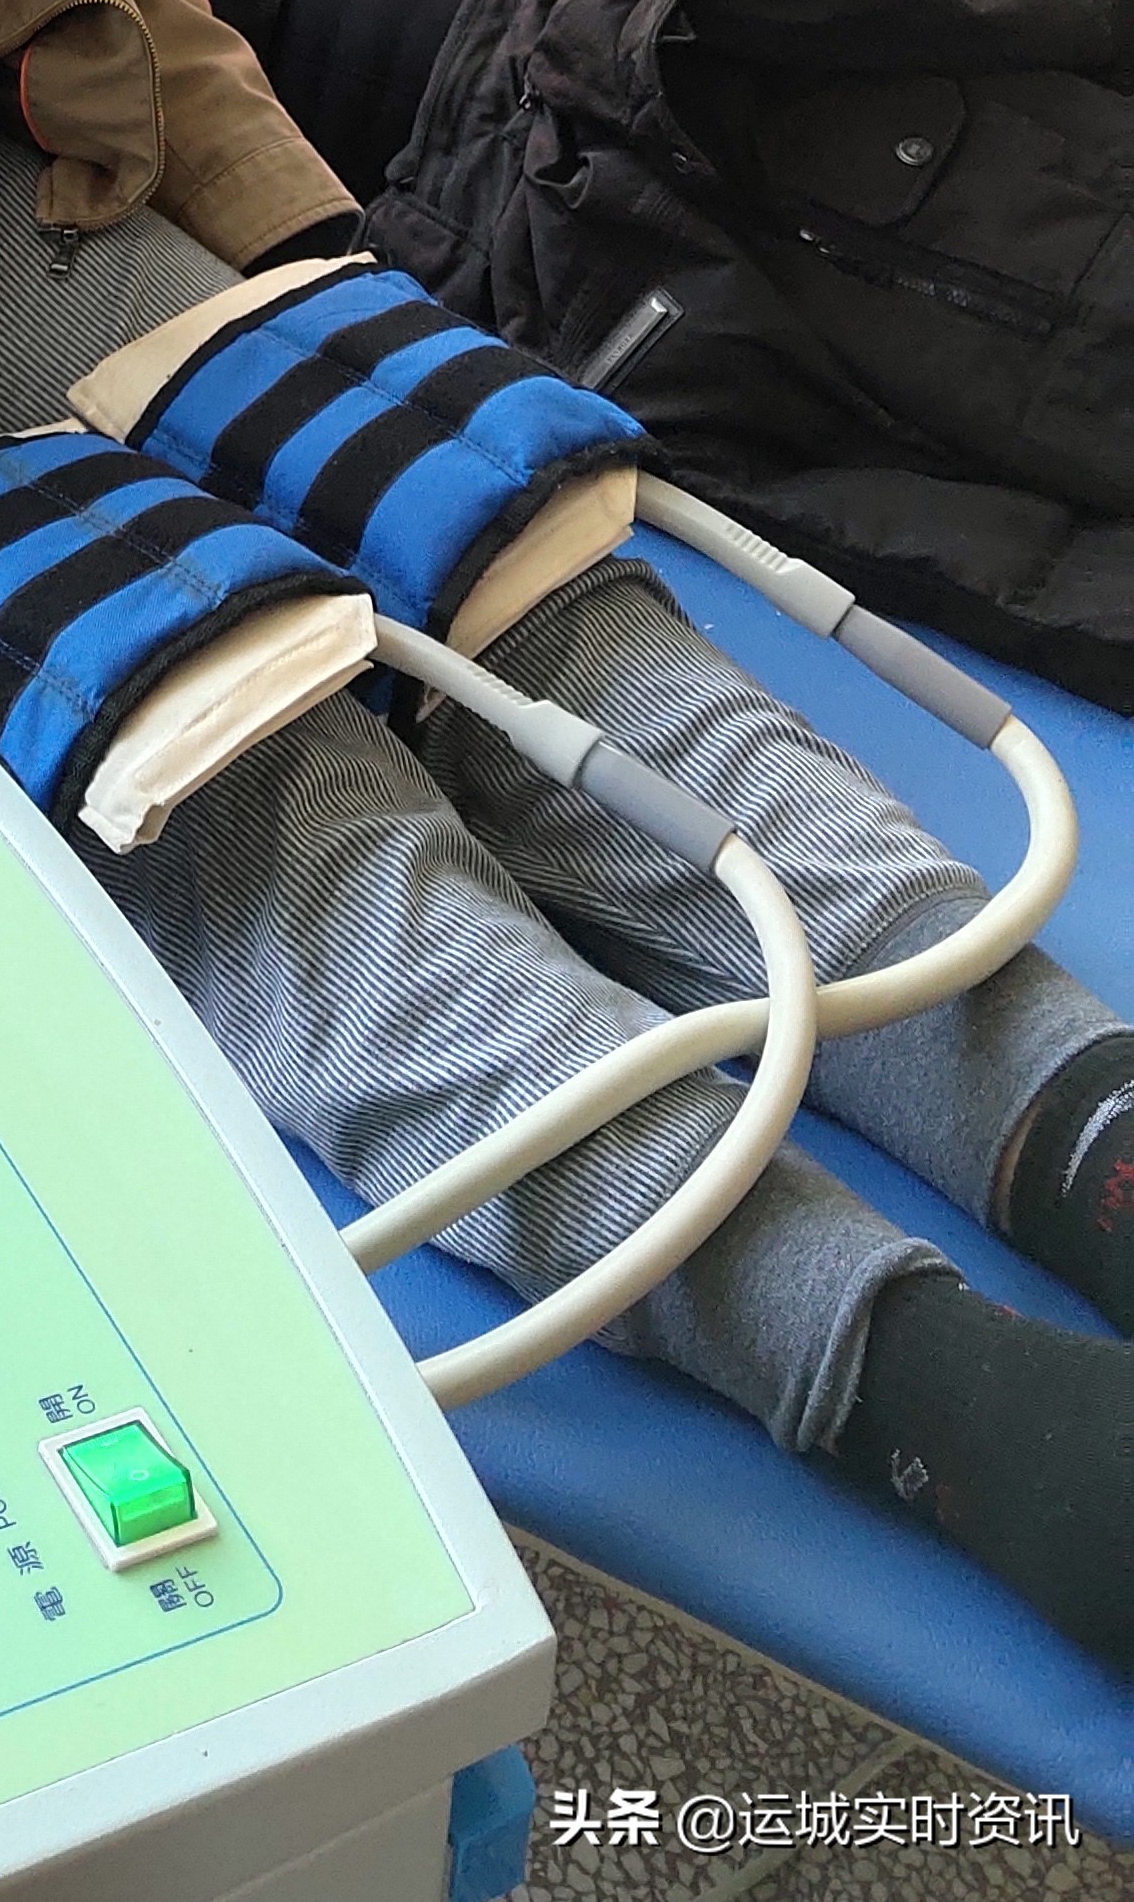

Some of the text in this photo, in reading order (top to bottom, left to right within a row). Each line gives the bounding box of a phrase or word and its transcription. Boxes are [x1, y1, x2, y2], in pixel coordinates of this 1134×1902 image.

[38, 1393, 73, 1423] 開
[67, 1384, 96, 1415] ON
[176, 1565, 214, 1608] OFF
